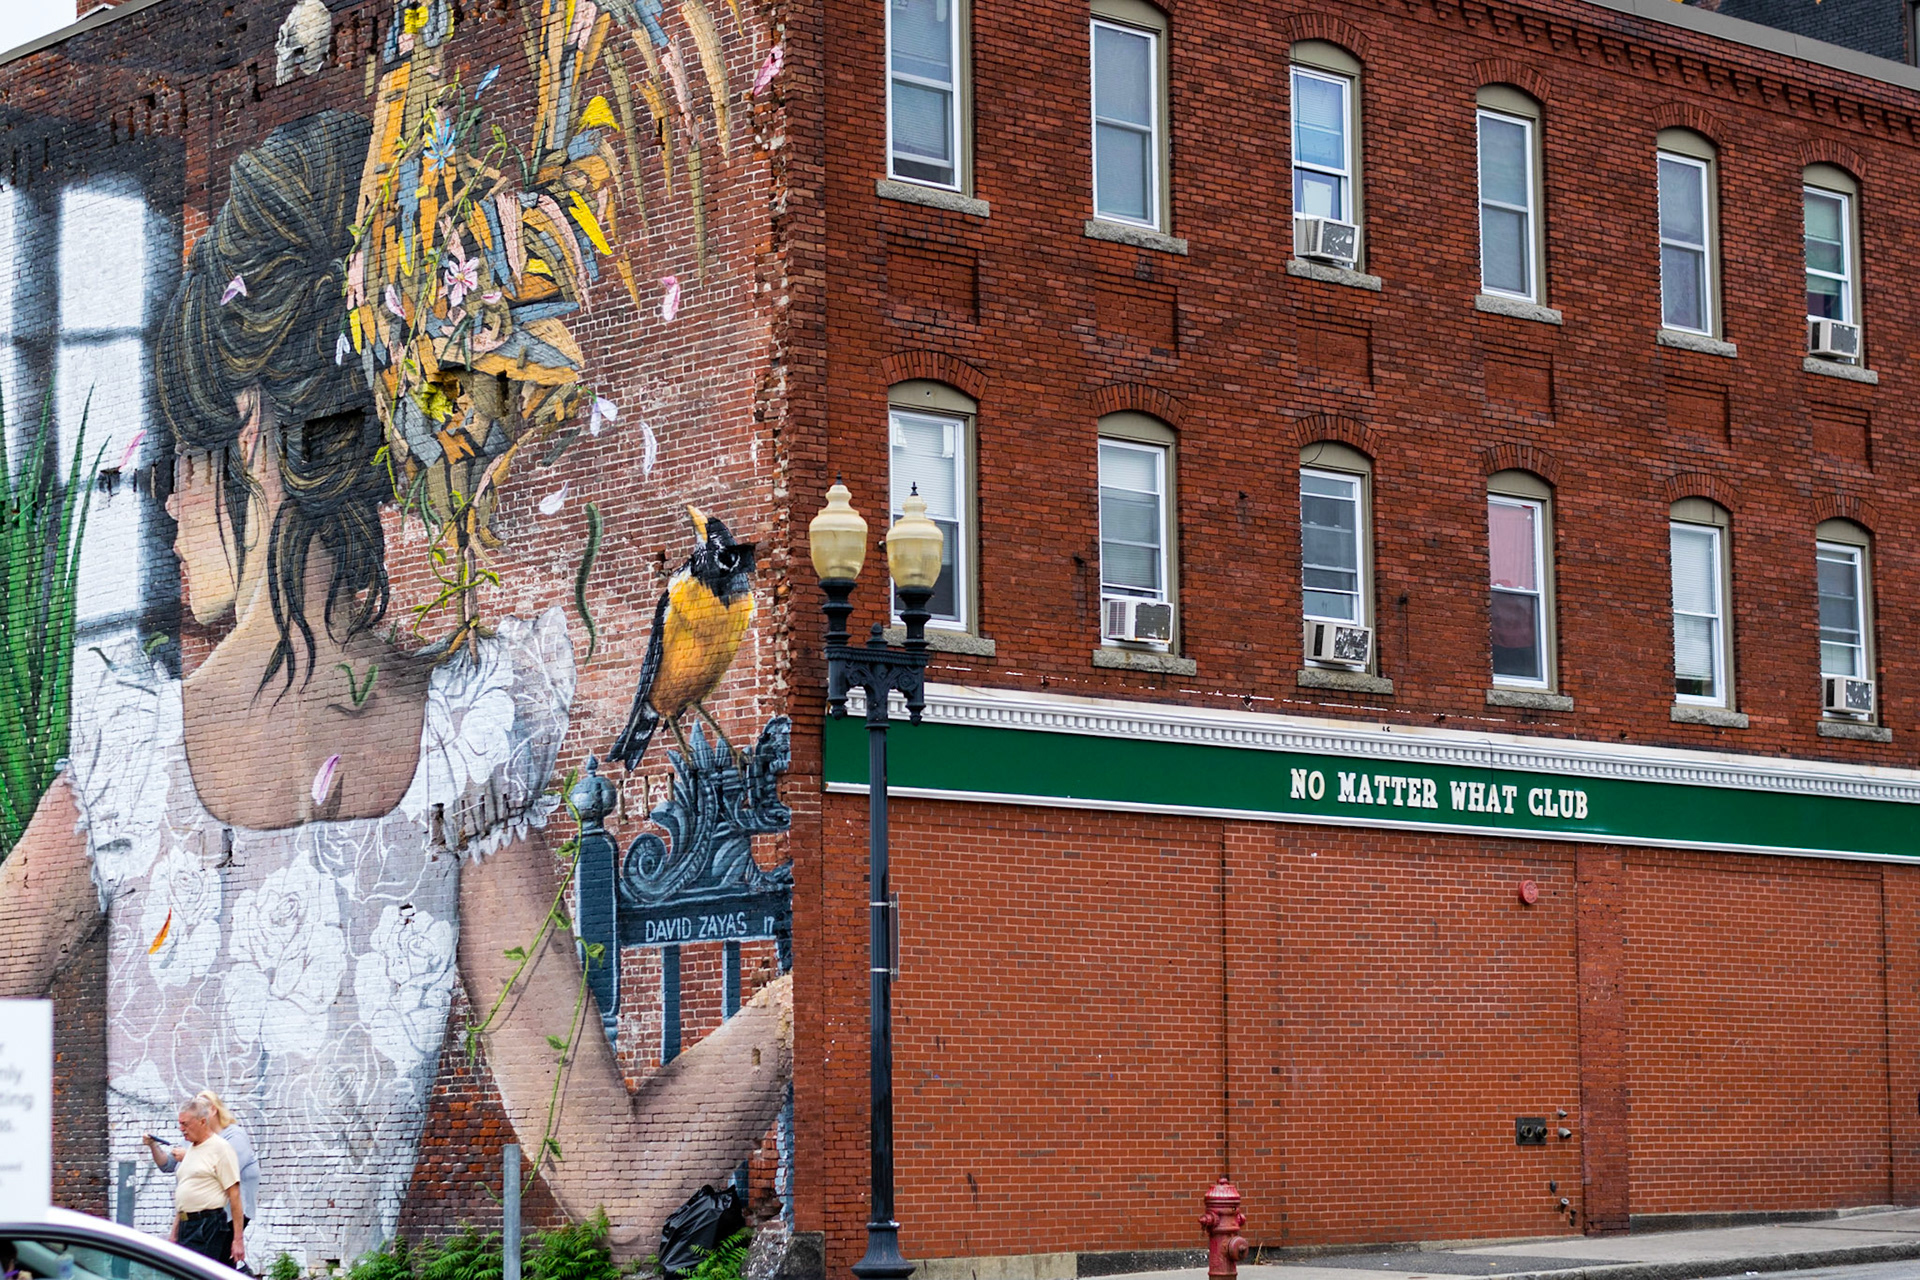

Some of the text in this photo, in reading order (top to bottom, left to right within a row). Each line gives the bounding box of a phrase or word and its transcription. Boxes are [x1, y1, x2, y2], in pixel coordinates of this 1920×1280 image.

[1290, 768, 1588, 819] NO MATTER WHAT CLUB
[645, 917, 691, 942] DAVID
[698, 912, 747, 937] ZAYAS
